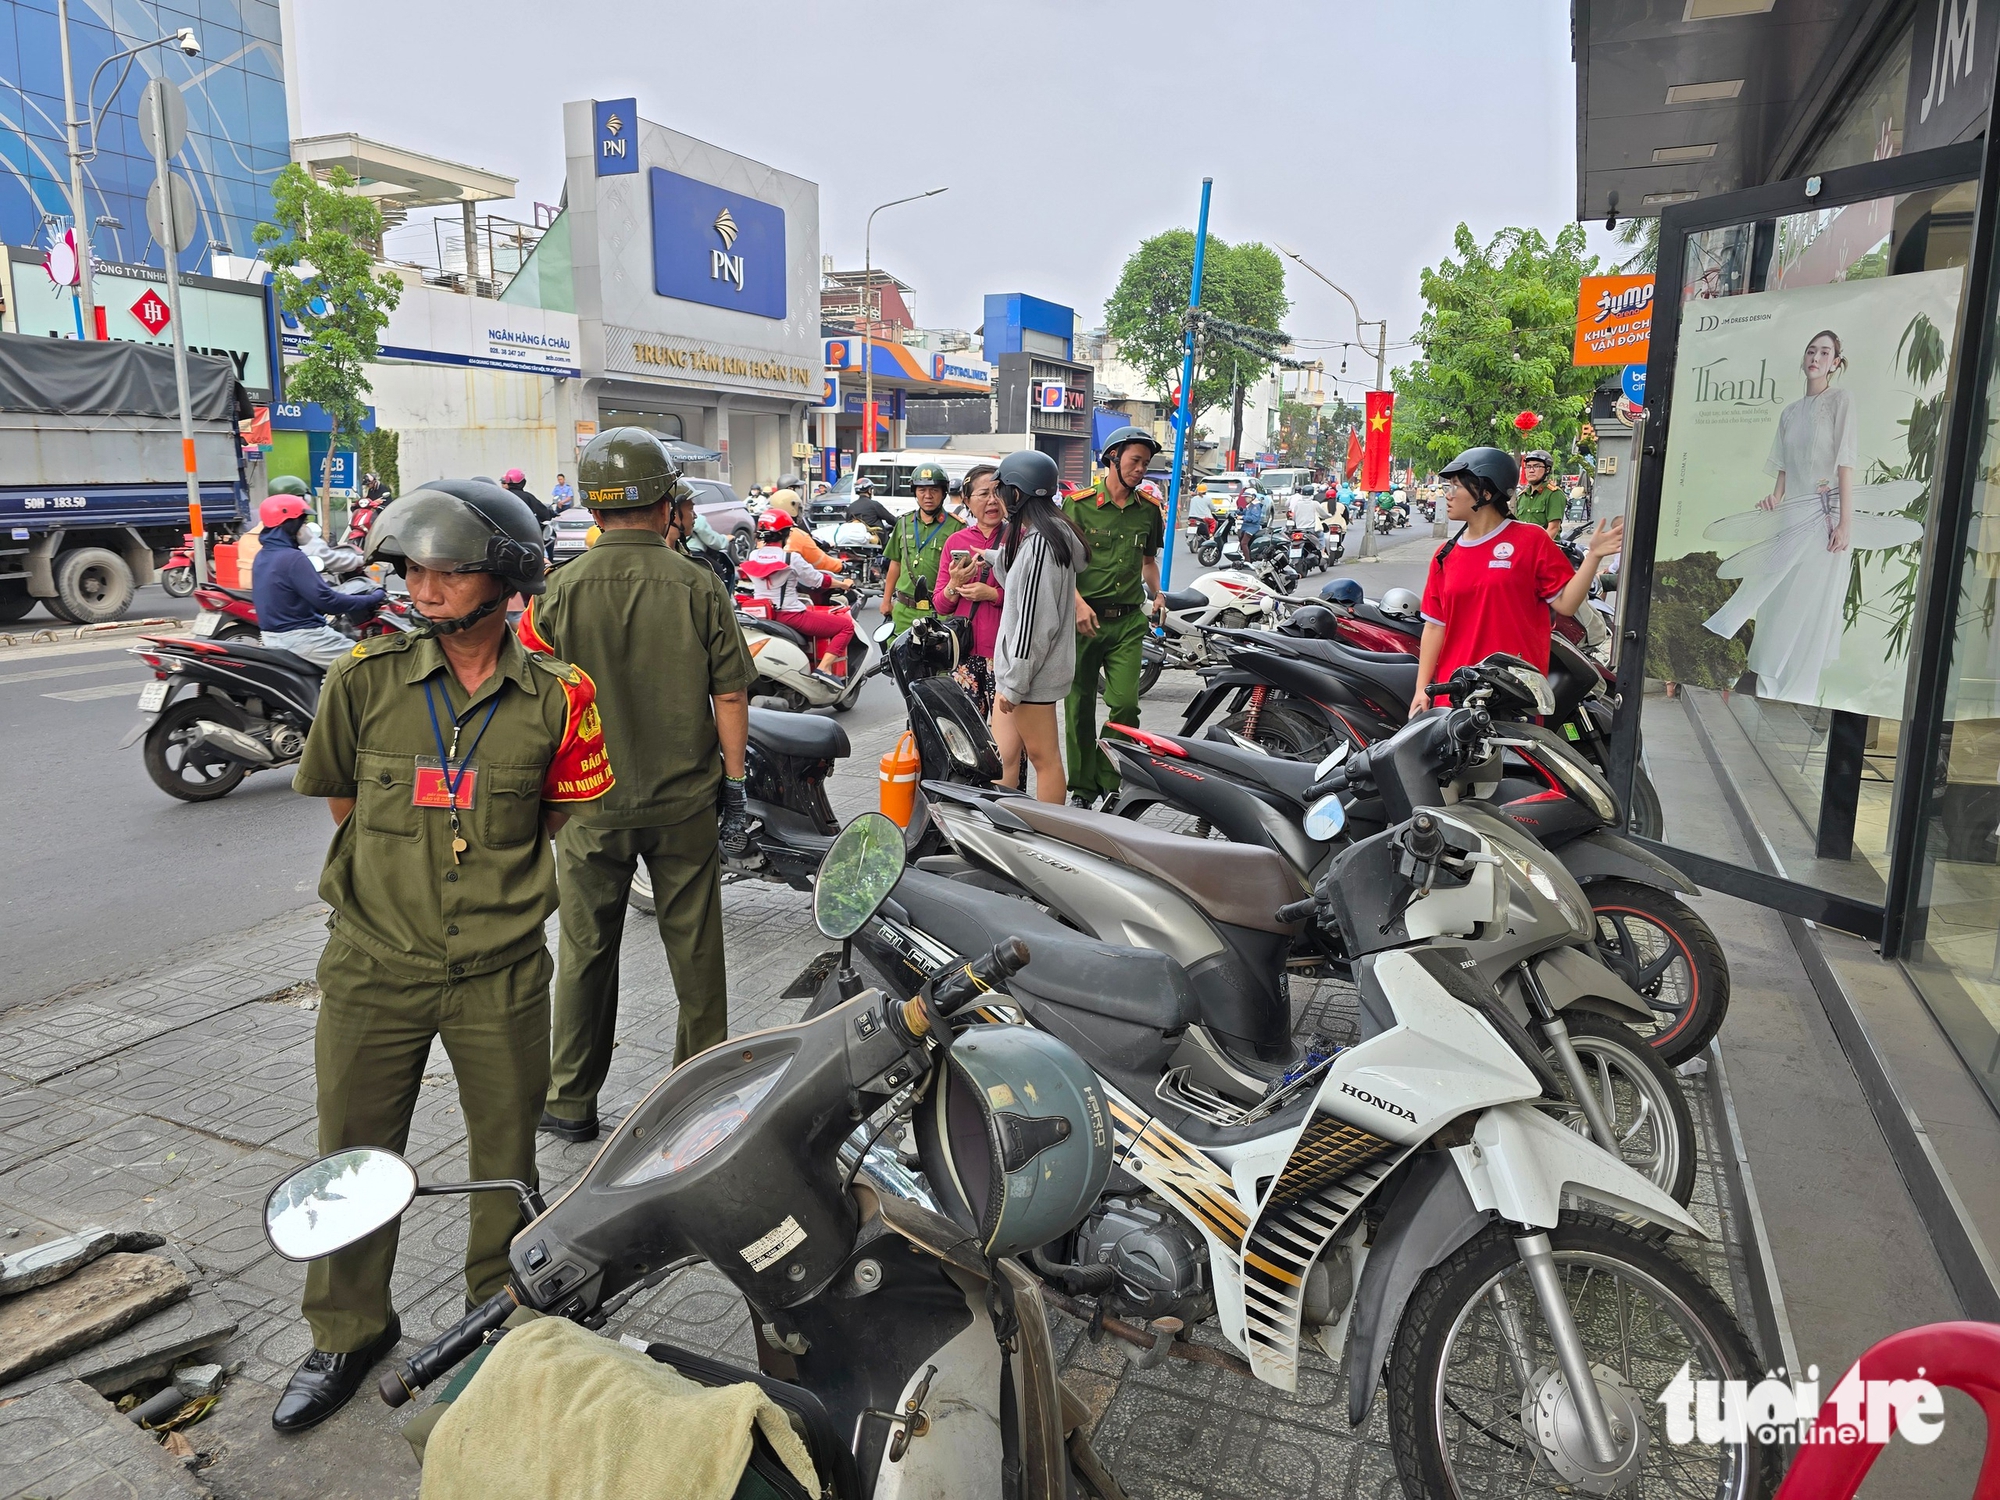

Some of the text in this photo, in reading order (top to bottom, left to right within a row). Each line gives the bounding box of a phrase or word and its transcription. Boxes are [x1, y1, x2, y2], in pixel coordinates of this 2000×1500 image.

[603, 139, 625, 159] PNJ
[124, 267, 139, 278] TY
[140, 270, 167, 283] TNHH
[710, 249, 744, 291] PNJ
[1749, 314, 1772, 322] DESIGN
[488, 329, 570, 349] NGÂN HÀNG Á CHÂU
[1611, 323, 1629, 335] VUI
[1591, 339, 1615, 353] VẬN
[633, 342, 811, 388] TRUNG TÂM KIM HOÀN PNJ
[944, 364, 988, 382] PETROLIMEX
[1692, 357, 1785, 407] Thanh
[276, 404, 301, 417] ACB
[25, 498, 45, 509] 50H
[53, 497, 86, 508] 183.50
[580, 752, 602, 773] BẢO
[1151, 757, 1205, 781] VISION
[558, 781, 575, 793] AN
[575, 772, 605, 792] NINH
[903, 958, 923, 977] MODERN
[1340, 1082, 1418, 1125] HONDA
[1083, 1086, 1106, 1146] HPRO
